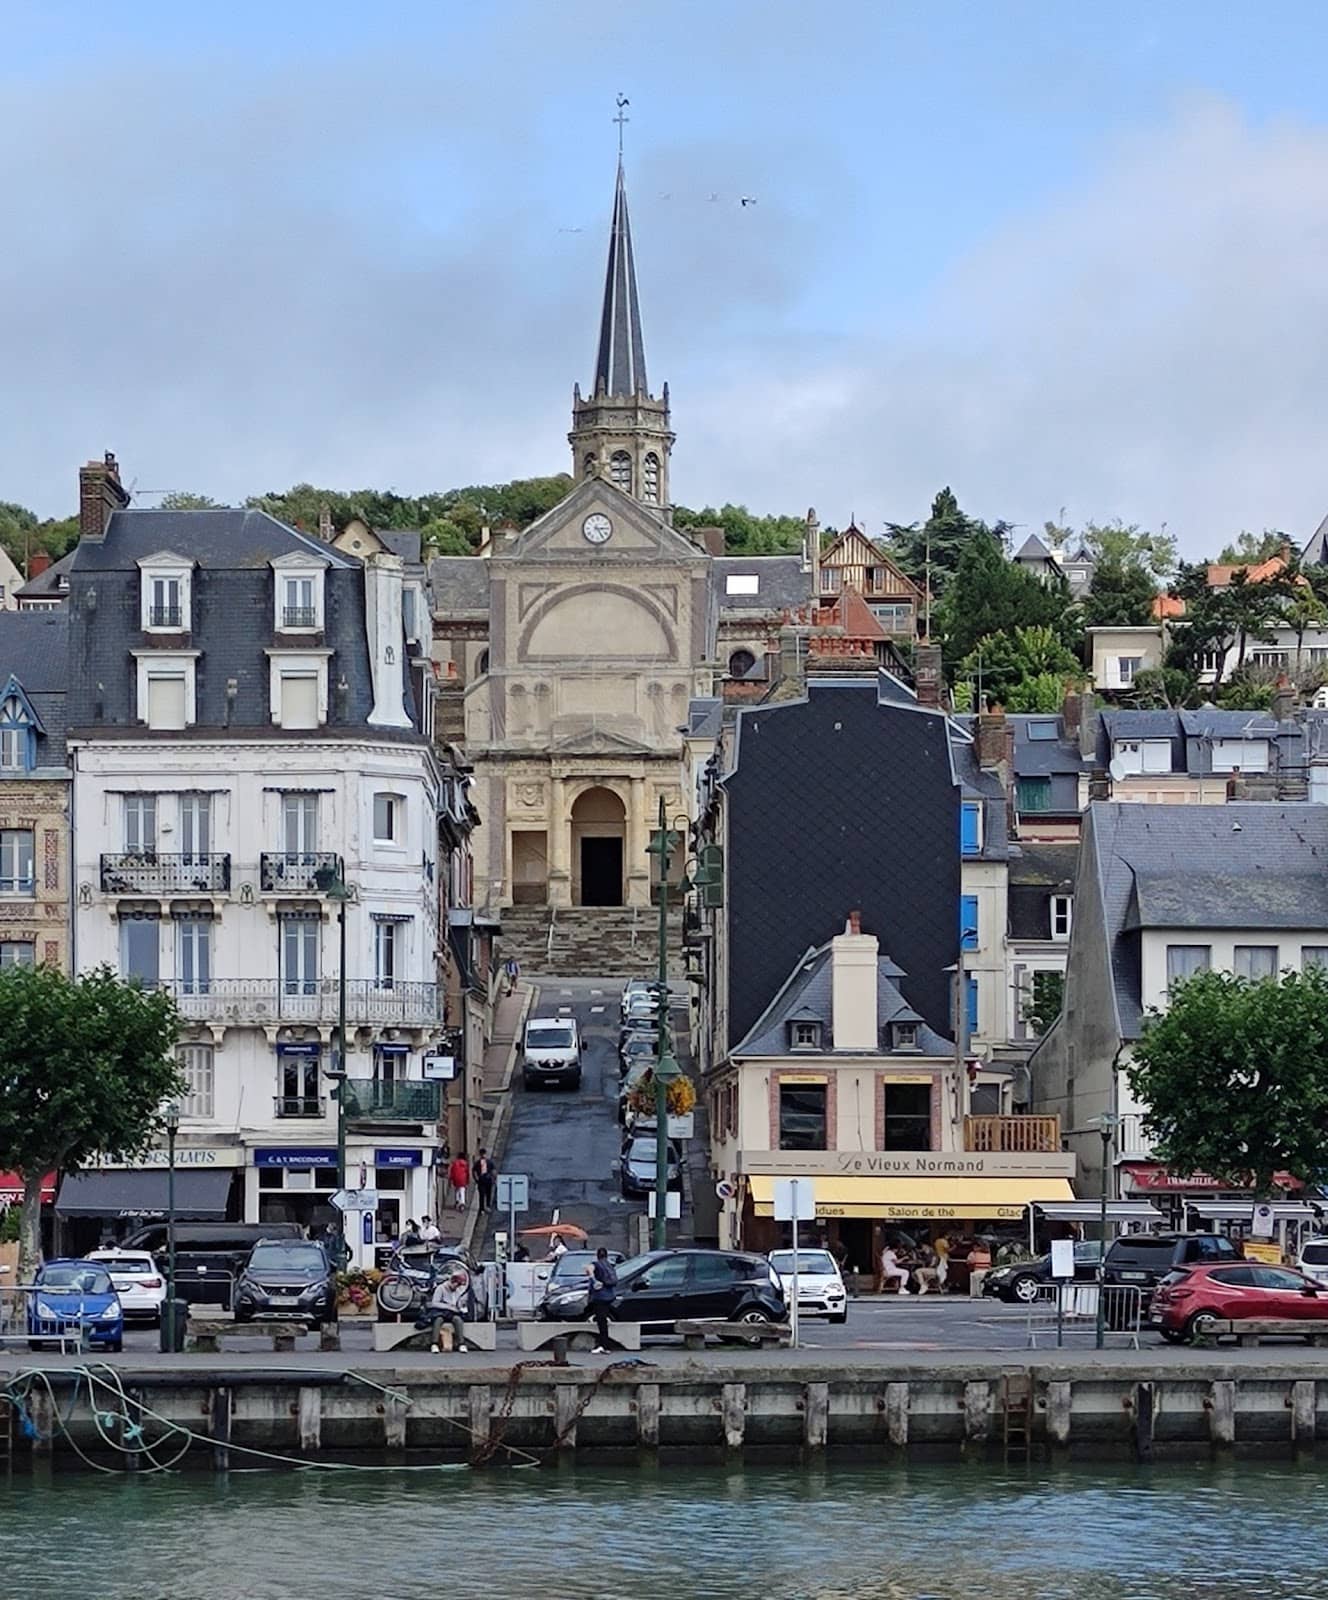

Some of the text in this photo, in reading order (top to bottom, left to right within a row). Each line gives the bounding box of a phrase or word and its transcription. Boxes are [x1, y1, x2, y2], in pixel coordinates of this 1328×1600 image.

[838, 1152, 985, 1173] Le Vieux Normand
[887, 1207, 918, 1217] Salon
[921, 1207, 935, 1217] de
